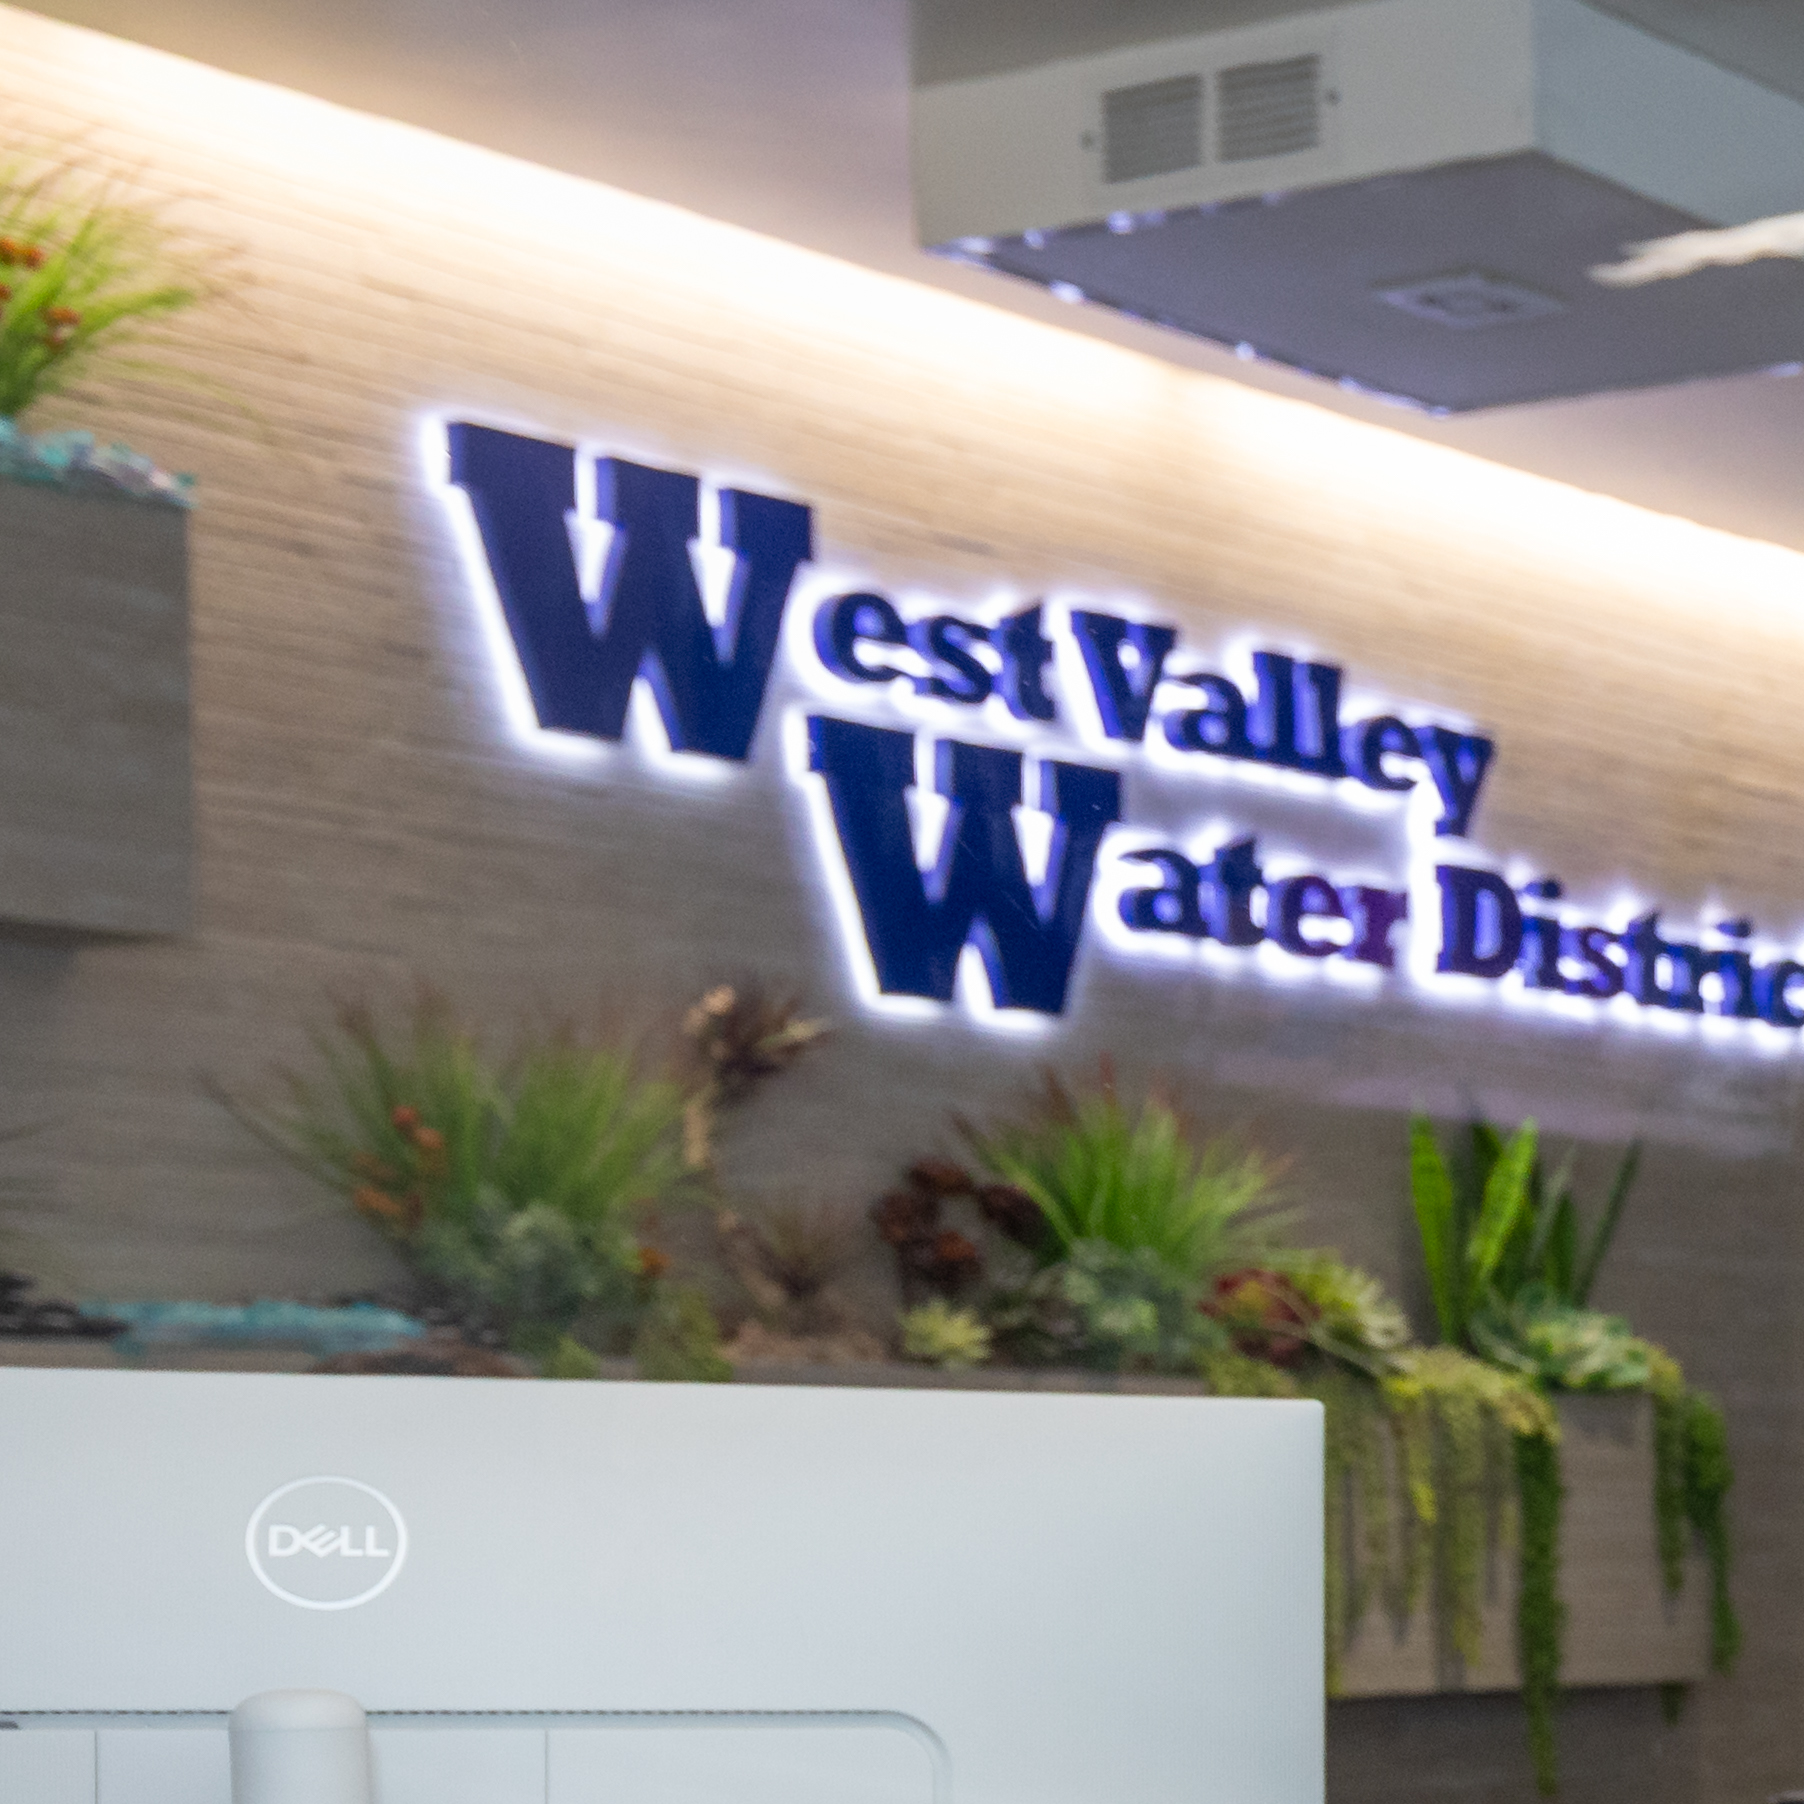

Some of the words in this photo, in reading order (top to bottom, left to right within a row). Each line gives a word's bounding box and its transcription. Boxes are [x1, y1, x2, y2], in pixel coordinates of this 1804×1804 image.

[446, 420, 1057, 762] West
[1069, 605, 1495, 836] Valley
[805, 712, 1401, 1017] Water
[267, 1523, 391, 1558] DELL
